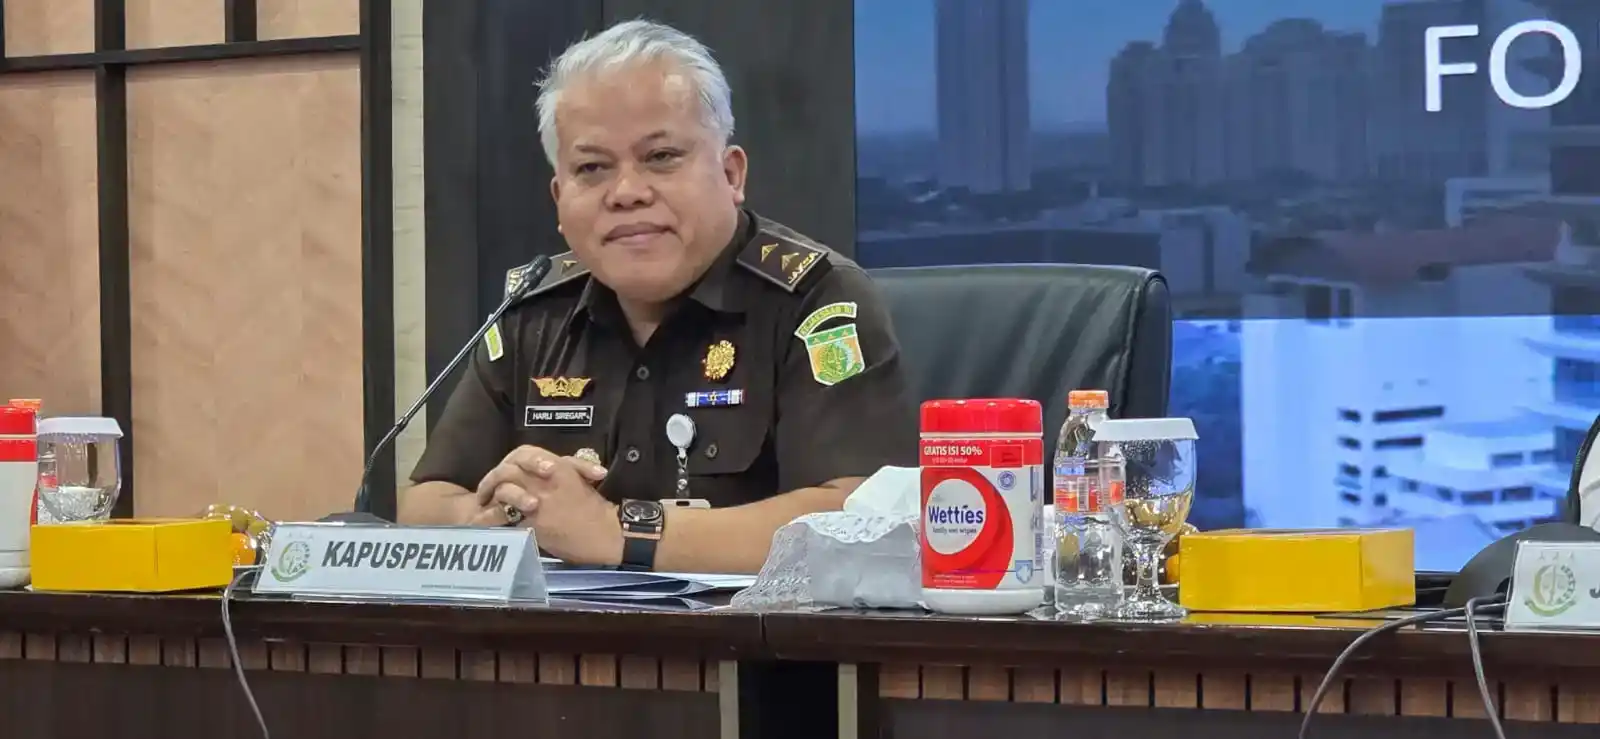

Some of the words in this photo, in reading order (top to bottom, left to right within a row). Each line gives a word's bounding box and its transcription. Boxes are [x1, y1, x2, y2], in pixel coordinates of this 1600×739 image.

[532, 411, 553, 420] HARLI
[924, 445, 947, 456] GRATIS
[948, 445, 959, 456] ISI
[960, 445, 983, 456] 50%
[928, 505, 983, 524] Wetties
[321, 541, 509, 573] KAPUSPENKUM
